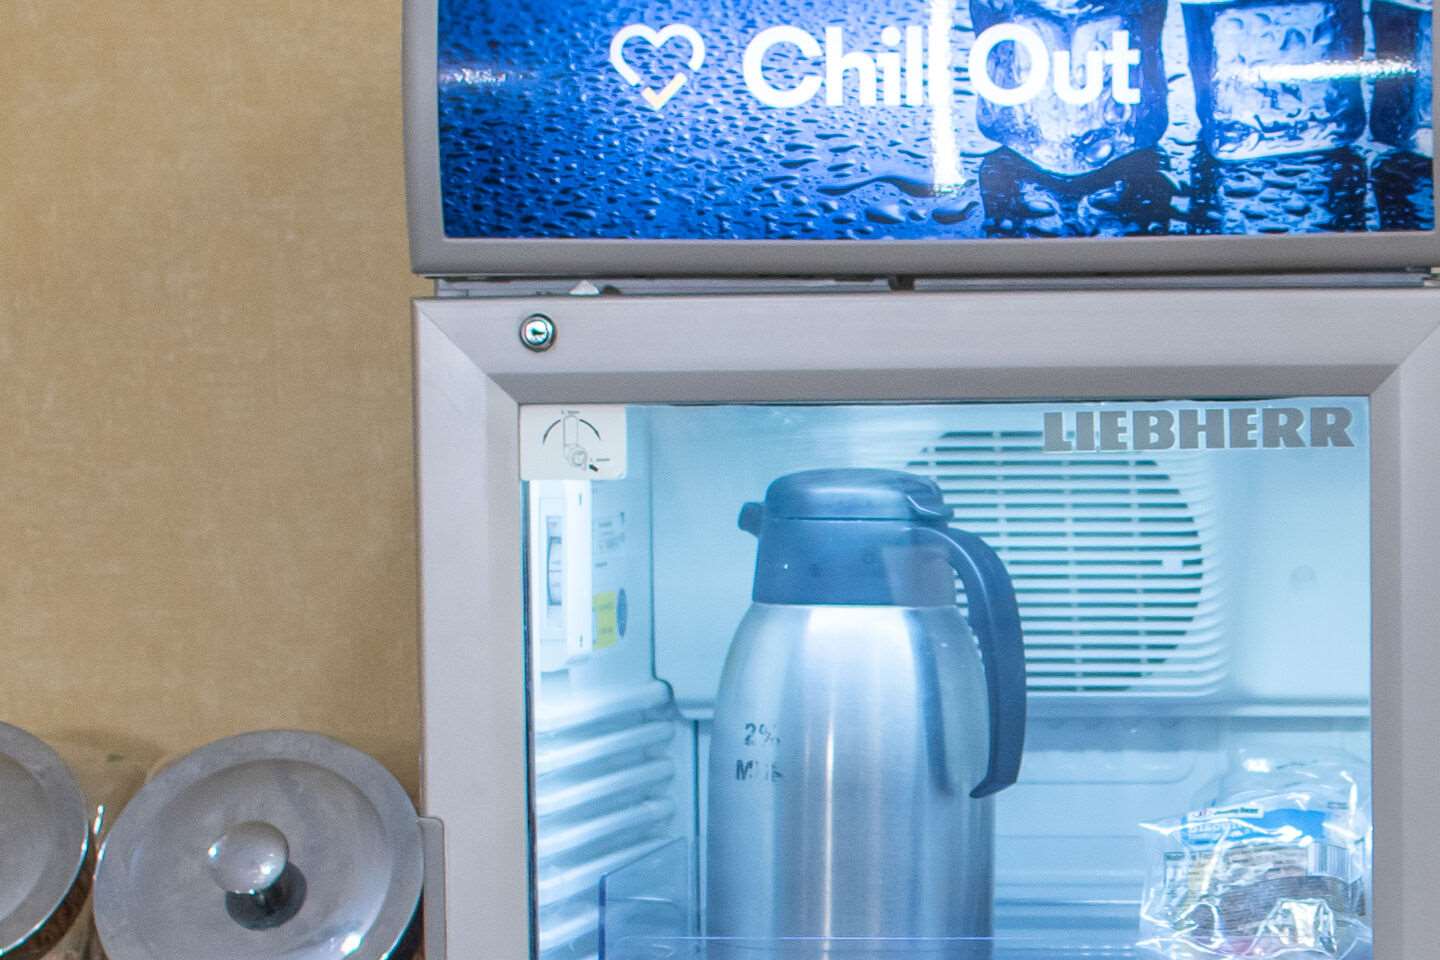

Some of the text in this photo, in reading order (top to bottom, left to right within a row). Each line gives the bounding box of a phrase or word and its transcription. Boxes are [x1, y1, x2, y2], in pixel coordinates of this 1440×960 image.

[742, 23, 1141, 107] Chill Out
[1043, 406, 1355, 451] LIEBHERR
